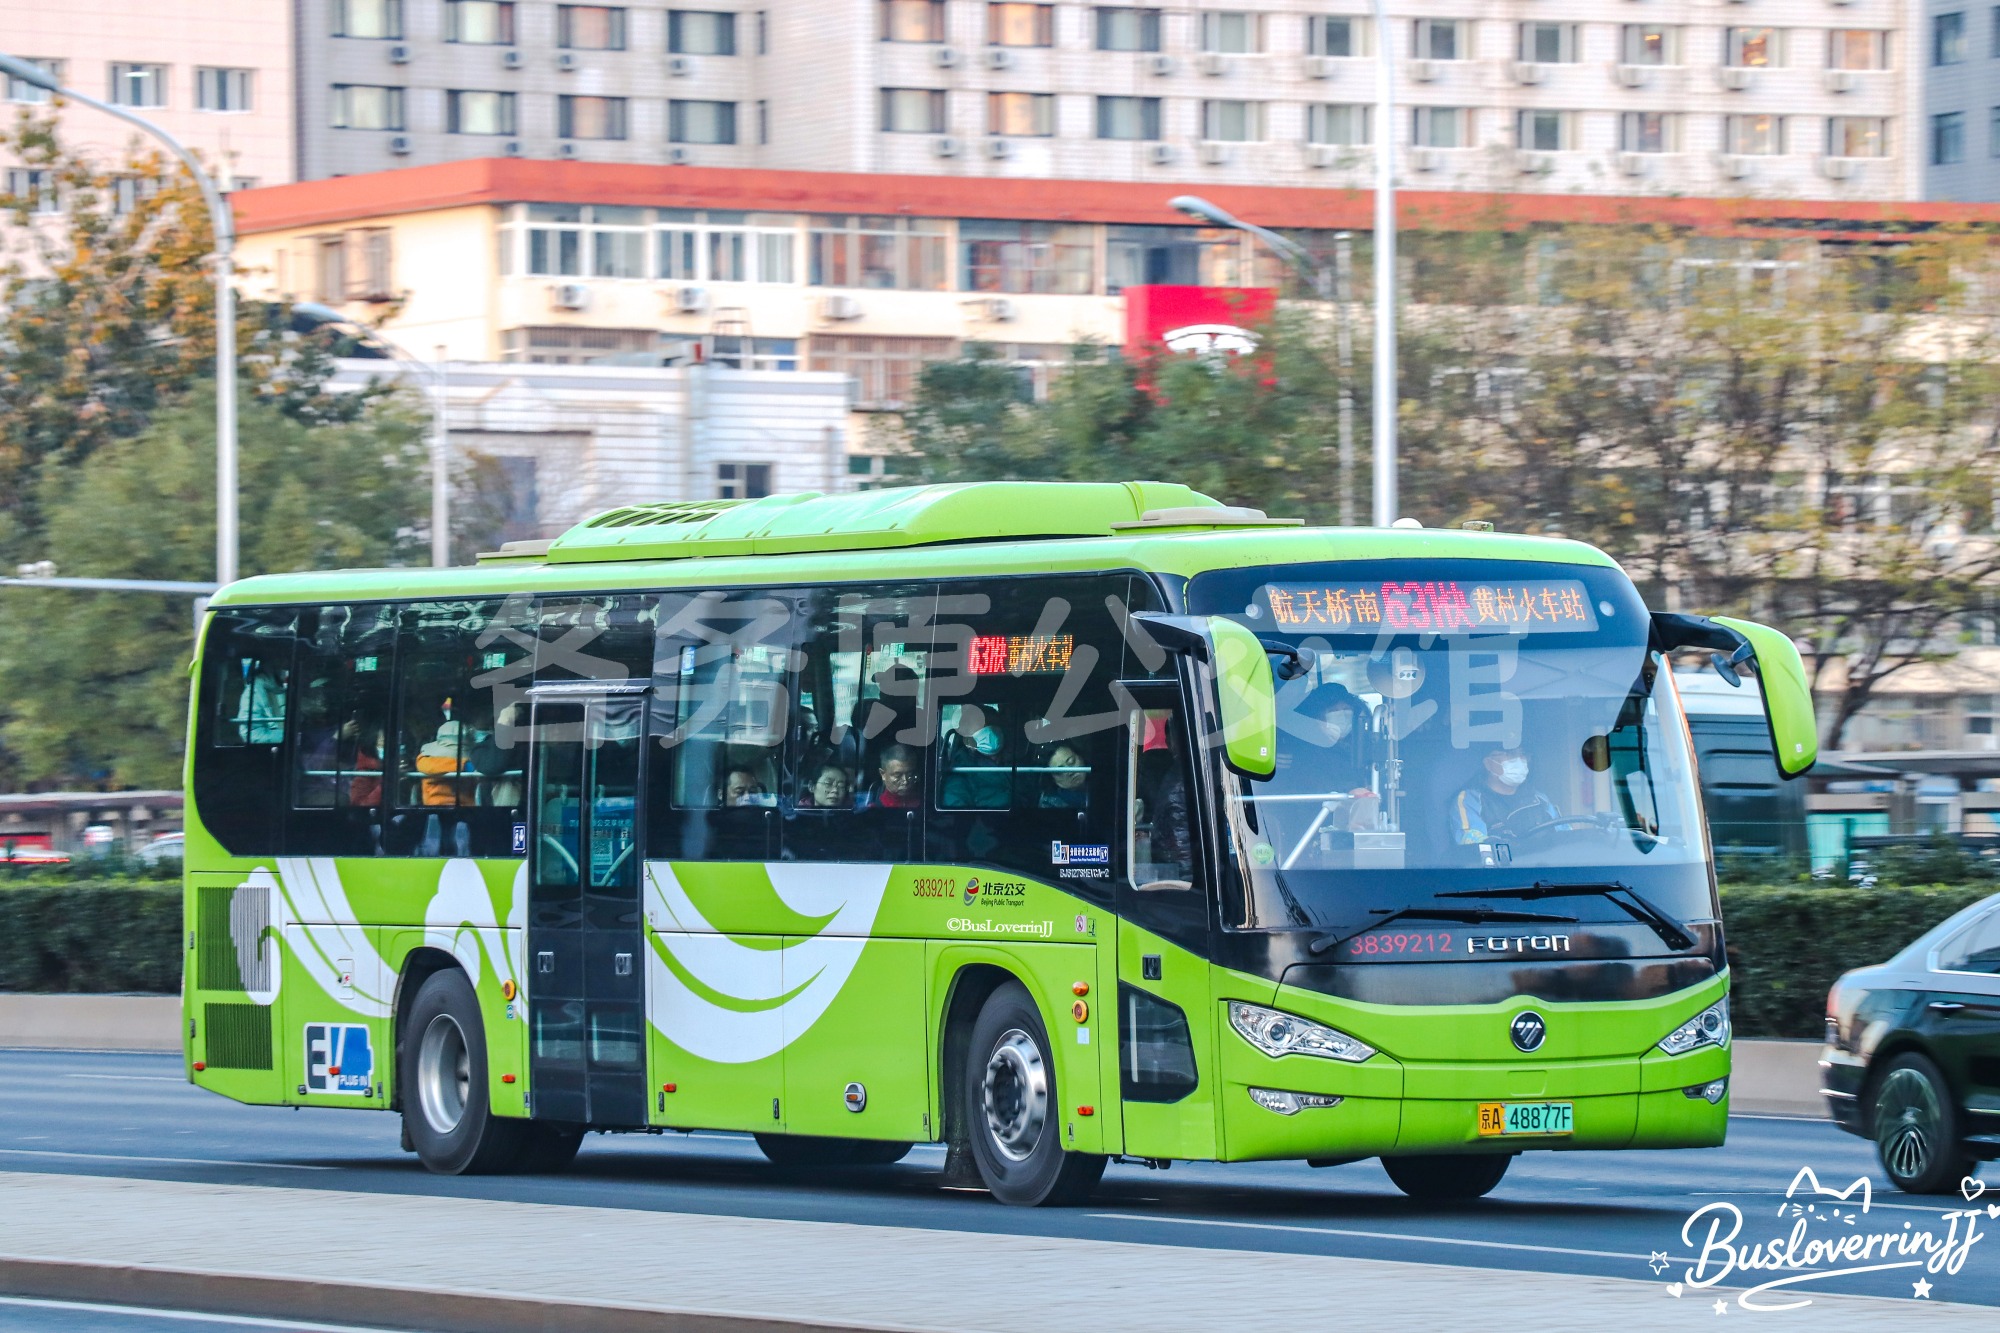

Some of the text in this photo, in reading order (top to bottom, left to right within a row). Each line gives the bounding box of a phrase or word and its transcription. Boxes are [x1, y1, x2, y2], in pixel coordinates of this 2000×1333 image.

[1271, 588, 1380, 624] 航天桥南
[1472, 586, 1586, 623] 黄村火车站
[912, 878, 956, 897] 3839212
[982, 882, 1026, 896] 北京公交
[980, 897, 1025, 907] Beijing Public Transport
[1350, 933, 1570, 955] 3839212 FOTON
[1509, 1106, 1572, 1130] 48877F
